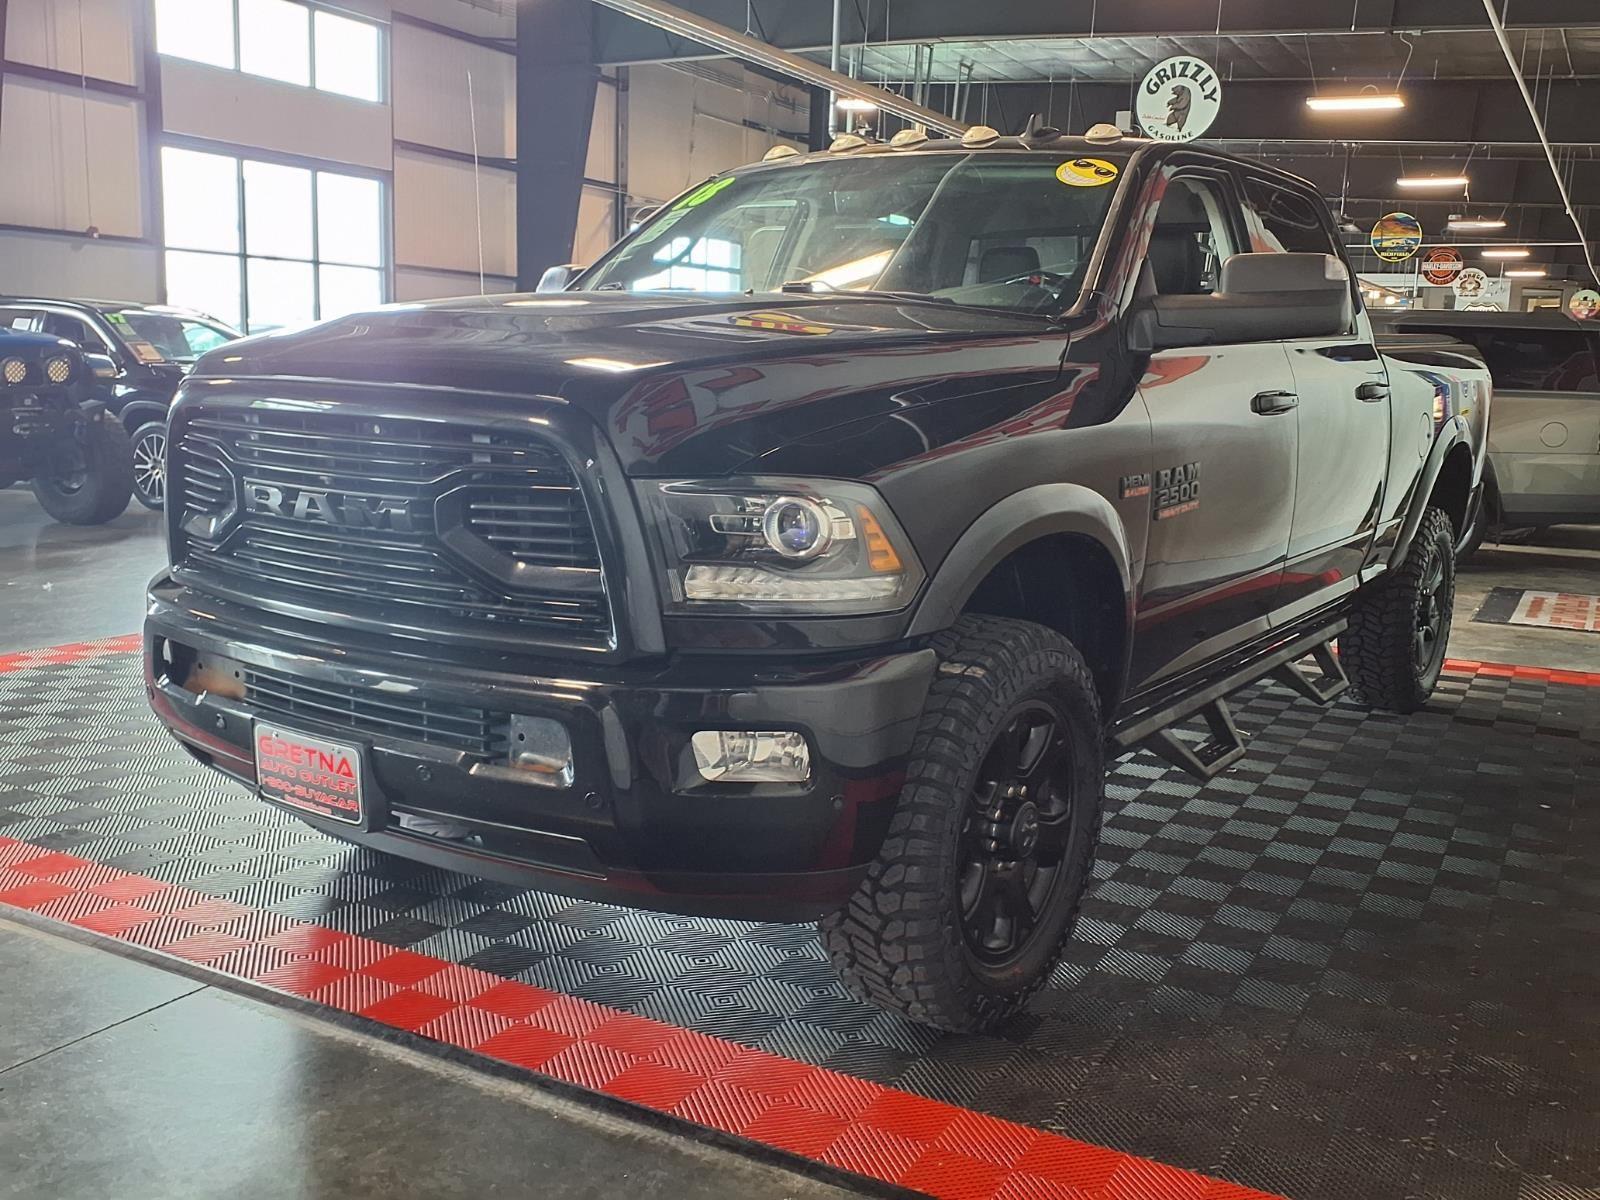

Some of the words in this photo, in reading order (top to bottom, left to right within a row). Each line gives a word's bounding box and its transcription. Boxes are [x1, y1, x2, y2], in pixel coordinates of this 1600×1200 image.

[1146, 61, 1217, 103] GRIZZLY
[1148, 125, 1193, 140] GASOLINE
[1124, 474, 1151, 488] HEMI
[1160, 462, 1200, 487] RAM
[244, 484, 413, 531] RAM
[1160, 481, 1200, 506] 2500
[259, 736, 356, 779] GRETNA
[262, 759, 297, 778] AUTO
[299, 770, 357, 795] OUTLET
